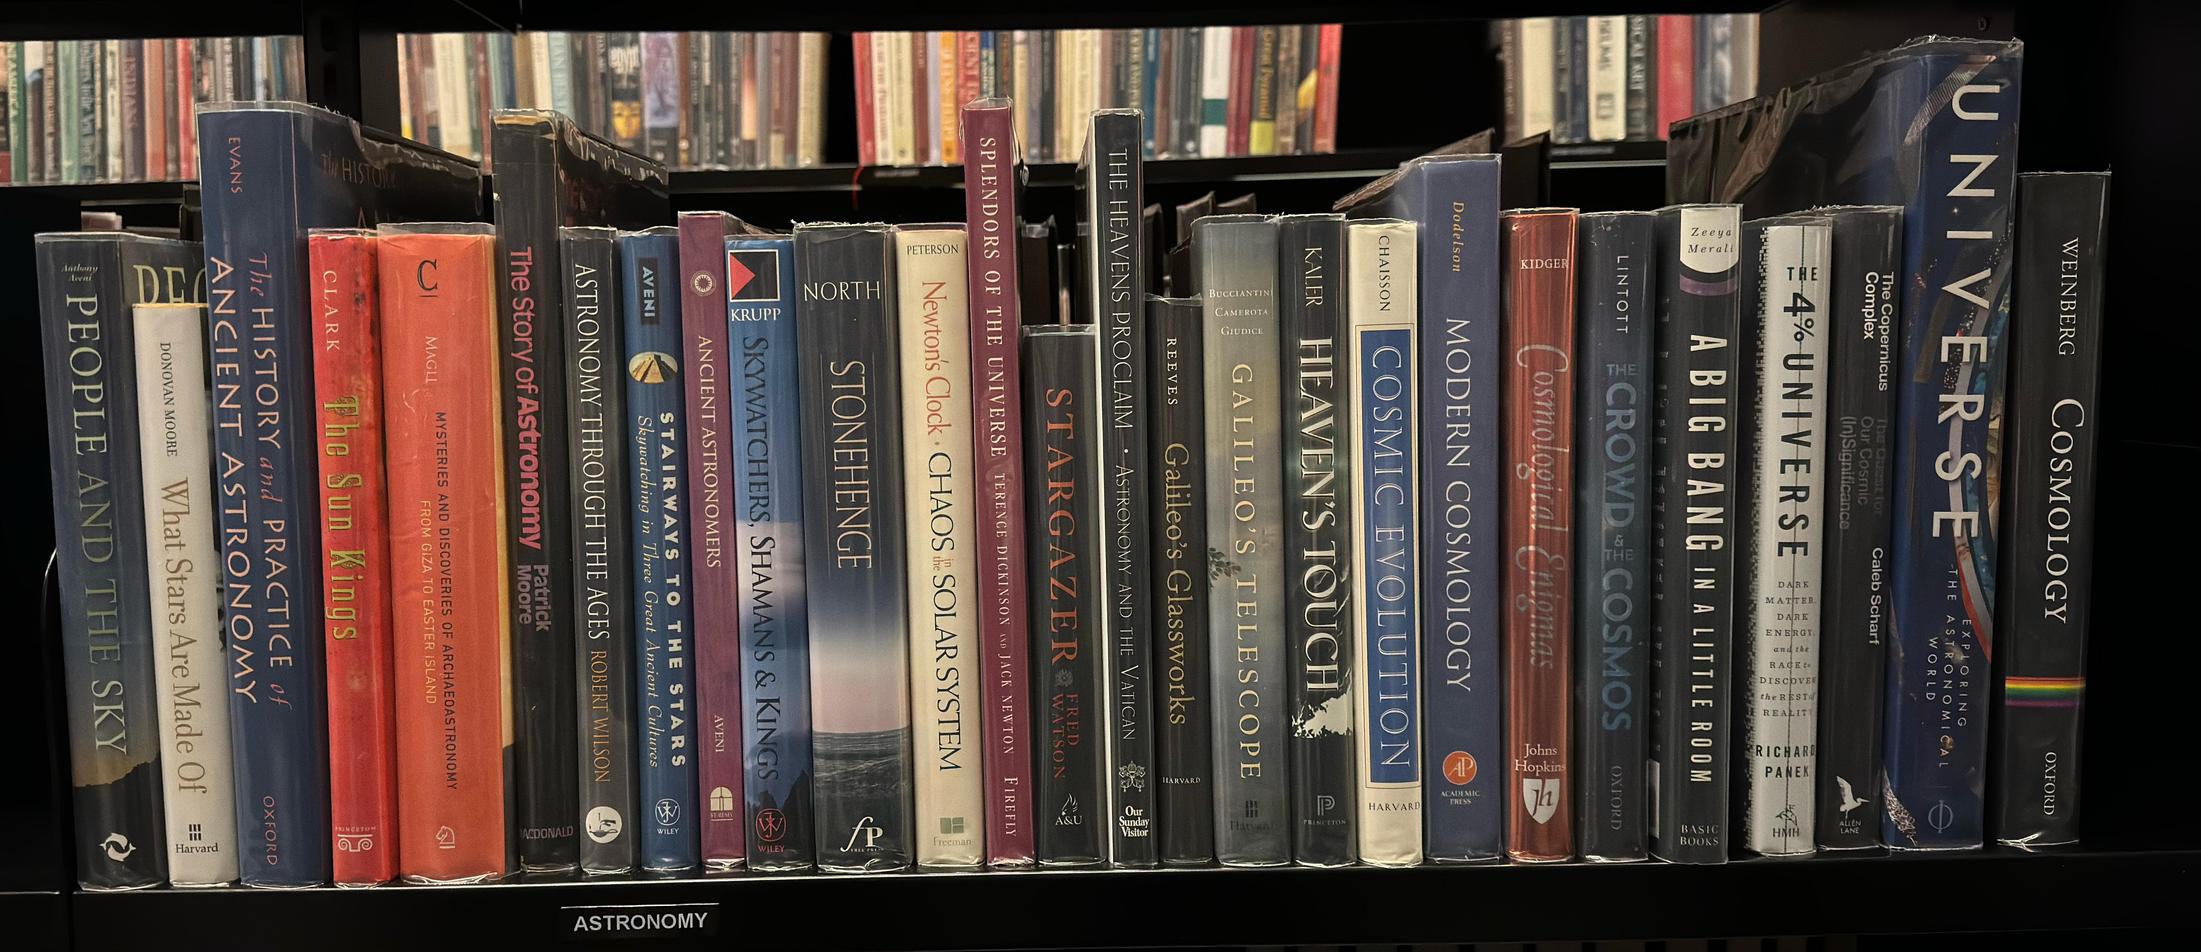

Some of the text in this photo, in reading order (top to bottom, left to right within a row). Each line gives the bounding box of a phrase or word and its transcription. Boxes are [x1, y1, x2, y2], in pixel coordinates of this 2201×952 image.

[228, 136, 243, 194] EVANS
[907, 244, 959, 256] PETERSON
[1452, 201, 1465, 272] Dodelson
[1520, 259, 1568, 270] KIDGER
[1688, 244, 1734, 254] Merali
[1691, 227, 1732, 238] Zeeya
[61, 263, 98, 274] Anthony
[642, 266, 655, 318] AVENI
[804, 281, 881, 301] NORTH
[979, 137, 1007, 457] SPLENDORS UNIVERSE
[1305, 247, 1323, 307] KALER
[1378, 235, 1391, 312] CHAISSON
[1616, 255, 1629, 333] LINTOTT
[2058, 236, 2079, 357] WEINBERG
[323, 270, 340, 352] CLARK
[731, 307, 781, 322] KRUPP
[1215, 307, 1268, 318] CAMEROTA
[1221, 326, 1263, 336] GIUDICE
[1862, 272, 1879, 340] Complex
[1878, 272, 1894, 391] The Copernicus
[1932, 84, 2000, 538] UNIVERSE
[160, 342, 178, 457] DONOVAN MOORE
[510, 247, 542, 550] The Story Astronomy
[1167, 337, 1178, 405] REEVES
[1606, 364, 1638, 376] THE
[210, 256, 257, 704] ANCIENT ASTRONOMY
[248, 252, 293, 668] The HISTORY and PRACTICE
[575, 263, 610, 640] ASTRONOMY THROUGH THE AGES
[698, 336, 721, 568] ANCIENT ASTRONOMERS
[829, 360, 873, 570] STONEHENGE
[1110, 200, 1140, 741] HEAVENS PROCLAIM ASTRONOMY VATICAN
[1604, 382, 1638, 528] CROWD
[1778, 353, 1815, 557] UNIVERSE
[66, 293, 127, 755] PEOPLE AND THE SKY
[324, 395, 366, 641] The Sun Kings
[994, 473, 1009, 538] TERENCE
[1045, 388, 1079, 665] STARGAZER
[1445, 318, 1471, 692] MODERN COSMOLOGY
[2044, 398, 2085, 624] COSMOLOGY
[925, 376, 962, 772] Clock CHAOS the SOLAR SYSTEM
[997, 545, 1010, 626] DICKINSON
[1372, 345, 1410, 767] COSMIC EVOLUTION
[1604, 549, 1633, 560] THE
[161, 476, 204, 754] What Stars Are Made
[420, 500, 437, 704] FROM GIZA TO EASTER ISLAND
[436, 412, 458, 790] MYSTERIES AND DISCOVERIES OF ARCHAEOASTRONOMY
[517, 565, 532, 625] Moore
[533, 564, 552, 632] Patrick
[637, 415, 666, 768] Skywatching in Three Great Ancient Cultures
[660, 412, 686, 767] STAIRWAYS THE STARS
[1304, 540, 1339, 692] TOUCH
[1685, 453, 1725, 782] BANG A LITTLE ROOM
[1868, 547, 1884, 646] Caleb Scharf
[750, 535, 781, 780] SHAMANS KINGS
[998, 653, 1011, 688] JACK
[1166, 569, 1196, 726] Glassworks
[1236, 574, 1261, 779] TELESCOPE
[1601, 568, 1634, 731] COSMOS
[1926, 637, 1938, 701] WORLD
[1958, 619, 1972, 727] EXPLORING
[590, 650, 610, 782] ROBERT WILSON
[1001, 695, 1014, 754] NEWTON
[1066, 693, 1080, 746] FRED
[1938, 614, 1956, 769] ASTRONOMICAL
[713, 715, 725, 753] AVENI
[1051, 693, 1067, 779] WATSON
[1515, 759, 1566, 776] Hopkins
[1524, 743, 1557, 759] Johns
[1756, 744, 1816, 757] RICHARD
[1162, 776, 1201, 784] HARVARD
[1765, 766, 1809, 778] PANEK
[2043, 752, 2057, 816] OXFORD
[263, 796, 278, 865] OXFORD
[1004, 777, 1018, 837] FIREFLY
[1055, 816, 1083, 825] A&U
[1119, 816, 1150, 828] Sunday
[1121, 826, 1149, 838] Visitor
[1125, 805, 1144, 817] Our
[1368, 802, 1421, 811] HARVARD
[1681, 824, 1719, 834] BASIC
[1772, 828, 1800, 838] HMH
[175, 842, 219, 854] Harvard
[757, 844, 785, 854] WILEY
[933, 837, 972, 847] Freeman
[1680, 836, 1719, 846] BOOKS
[574, 912, 708, 932] ASTRONOMY
